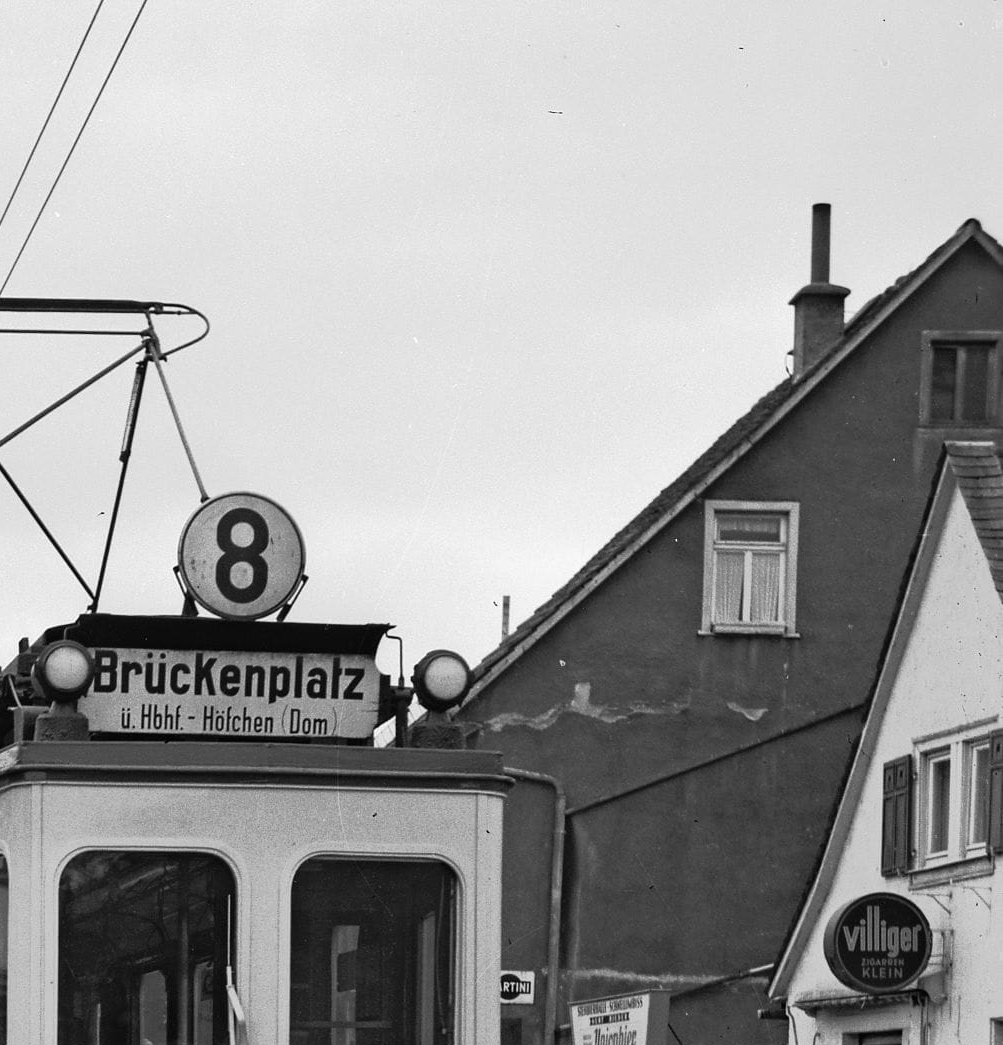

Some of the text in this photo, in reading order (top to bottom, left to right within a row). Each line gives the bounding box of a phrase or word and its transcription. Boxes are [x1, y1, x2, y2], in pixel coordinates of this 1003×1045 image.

[215, 507, 269, 604] 8
[93, 650, 365, 704] Brückenplatz
[141, 704, 183, 730] Hbhf.
[202, 705, 274, 734] Höfchen
[282, 704, 337, 736] (Dom)
[842, 905, 922, 958] villiger
[861, 958, 905, 967] ZIGARREN
[862, 967, 903, 979] KLEIN
